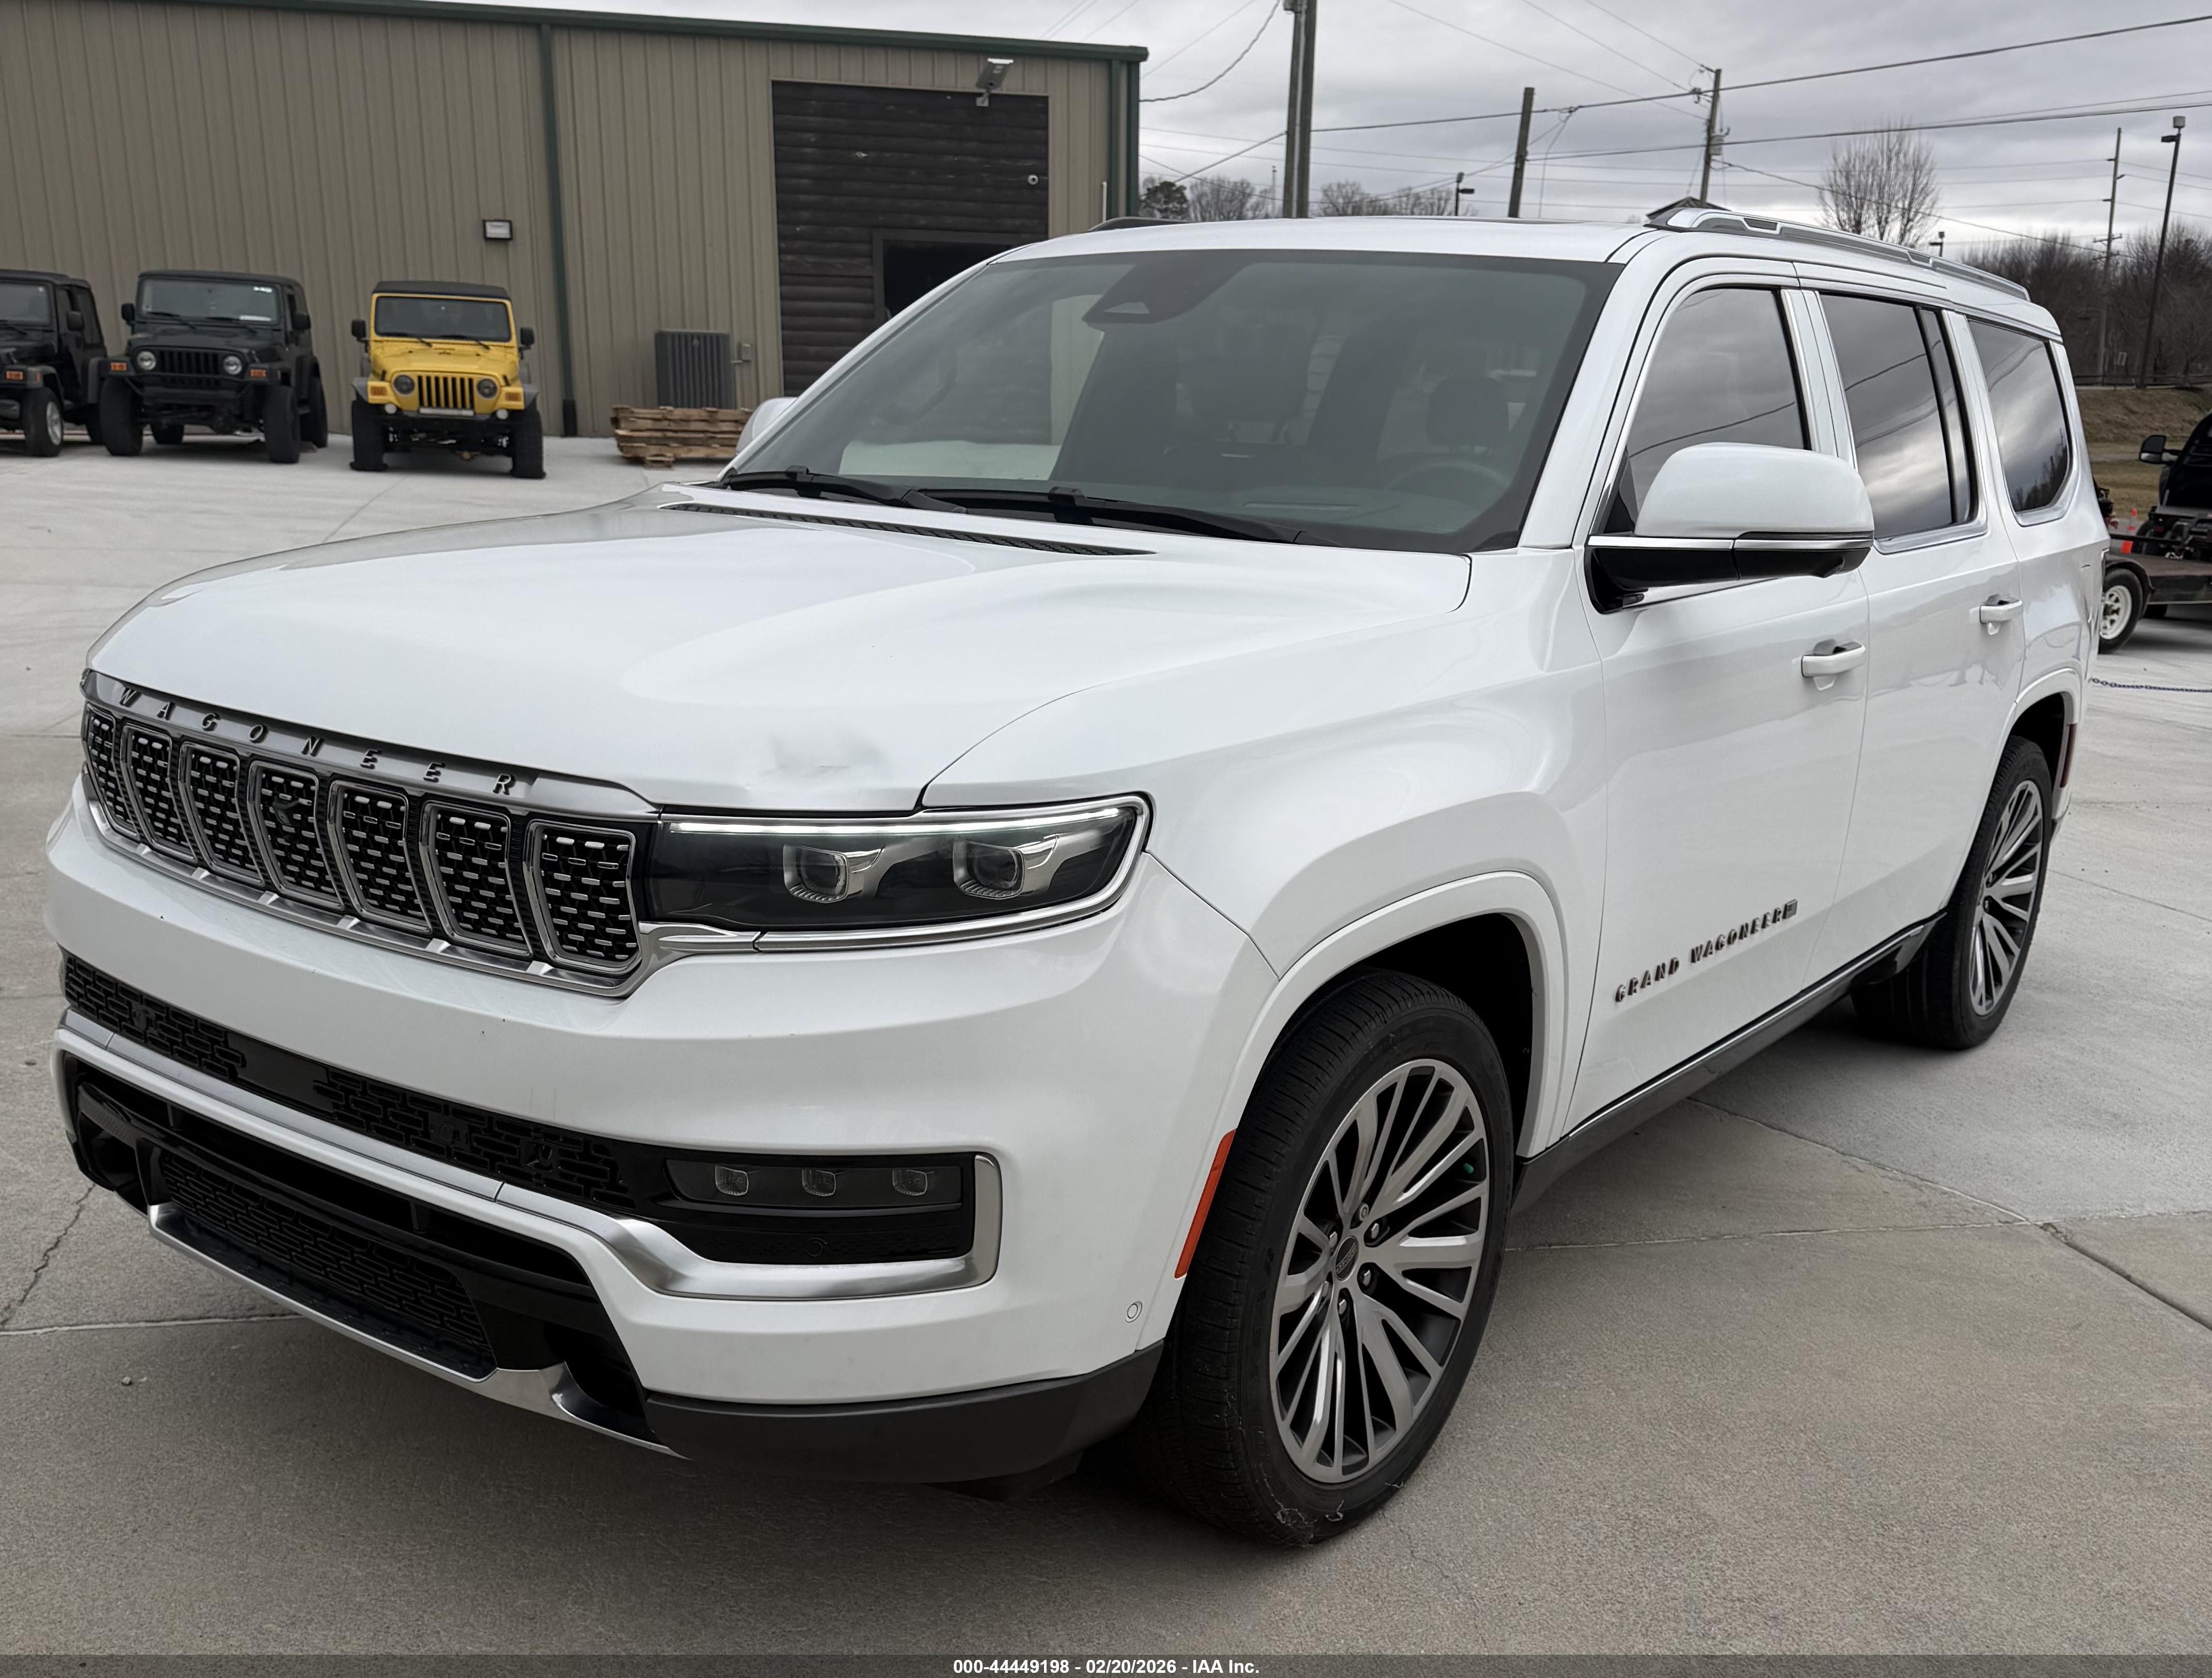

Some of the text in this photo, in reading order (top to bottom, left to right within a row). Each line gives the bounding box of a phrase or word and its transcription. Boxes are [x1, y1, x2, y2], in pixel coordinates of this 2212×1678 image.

[119, 689, 515, 796] WAGONEER
[1615, 907, 1782, 1002] GRAND WAGONEER
